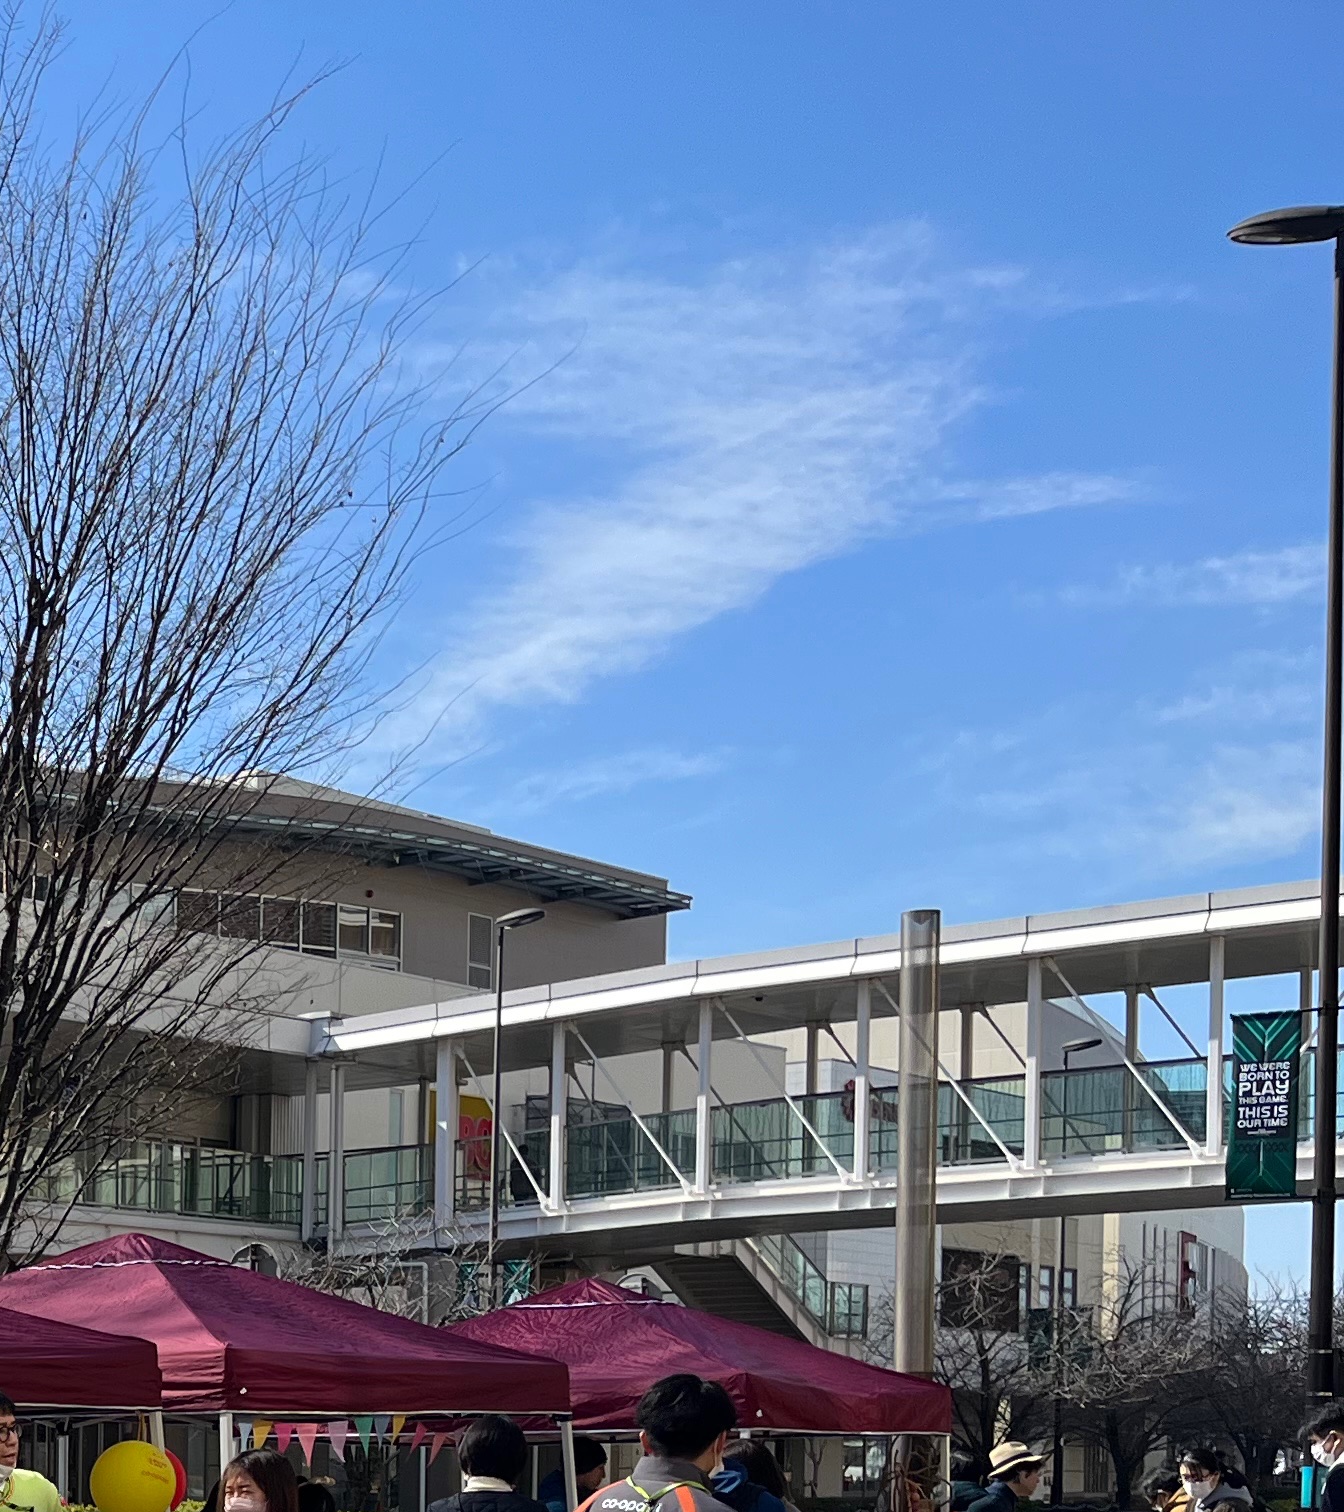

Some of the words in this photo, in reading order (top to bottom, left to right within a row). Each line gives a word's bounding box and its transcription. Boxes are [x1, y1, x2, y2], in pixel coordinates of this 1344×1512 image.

[1240, 1063, 1257, 1072] WE
[1259, 1061, 1290, 1071] WERE
[1239, 1072, 1273, 1082] BORN
[1275, 1070, 1290, 1080] TO
[1239, 1080, 1290, 1095] PLAY
[1239, 1096, 1258, 1104] THIS
[1238, 1106, 1271, 1119] THIS
[1274, 1104, 1289, 1117] IS
[1237, 1119, 1262, 1128] OUR
[1263, 1118, 1288, 1127] TIME
